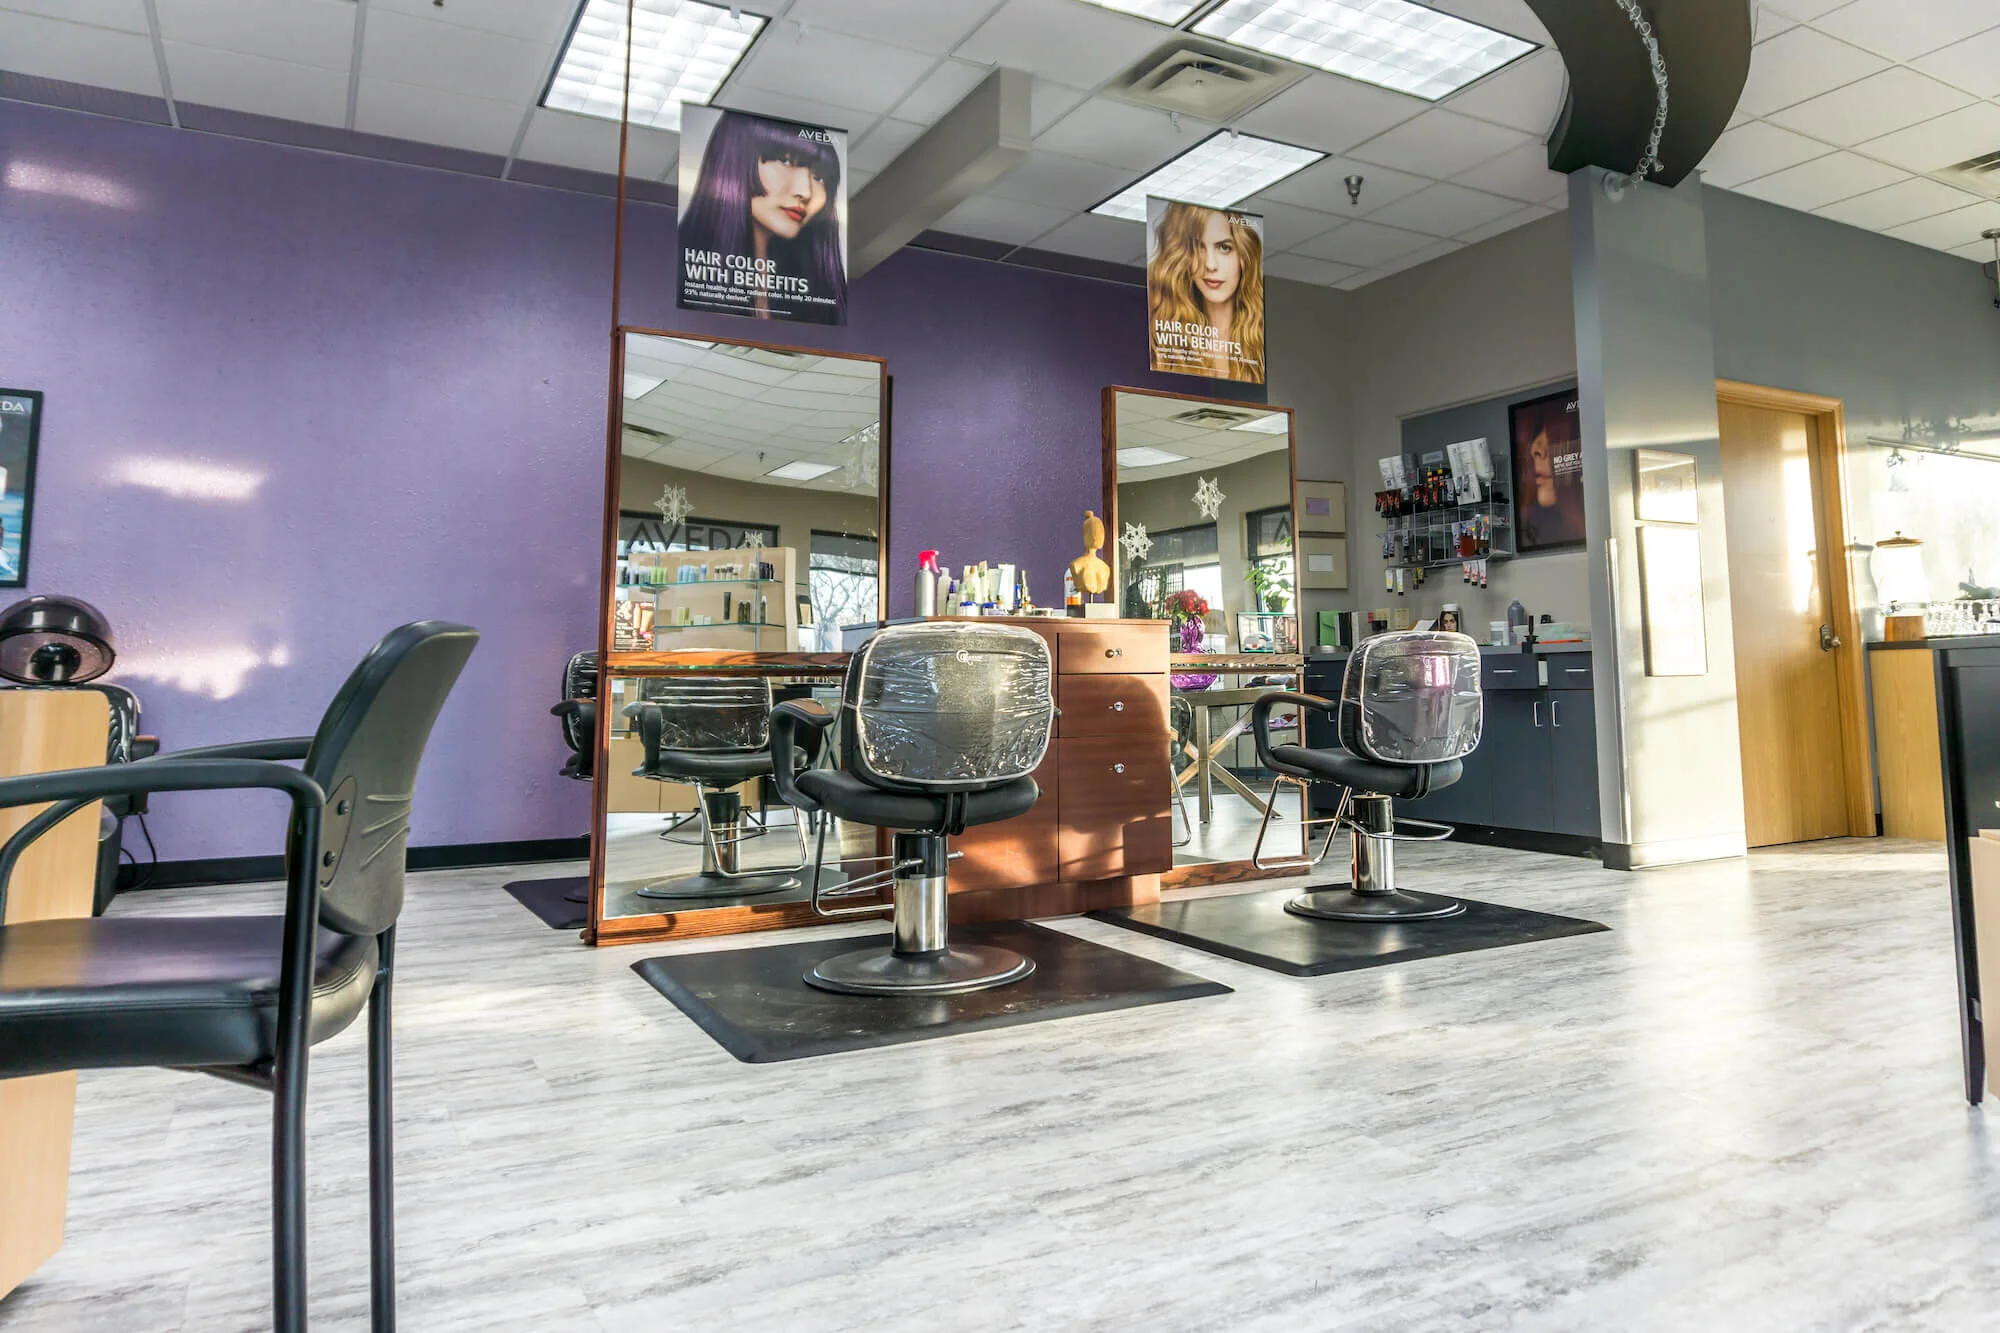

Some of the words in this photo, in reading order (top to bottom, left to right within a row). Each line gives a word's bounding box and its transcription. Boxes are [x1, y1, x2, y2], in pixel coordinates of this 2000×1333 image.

[798, 129, 840, 145] AVED
[1228, 216, 1257, 227] AVE
[684, 247, 721, 267] HAIR
[725, 254, 776, 274] COLOR
[685, 263, 728, 284] WITH
[733, 270, 809, 293] BENEFITS
[1155, 319, 1182, 333] HAIR
[1185, 322, 1218, 338] COLOR
[1156, 332, 1188, 347] WITH
[1191, 336, 1241, 354] BENEFITS
[0, 400, 25, 412] DA
[1553, 455, 1563, 464] NO
[1563, 452, 1579, 462] GREY
